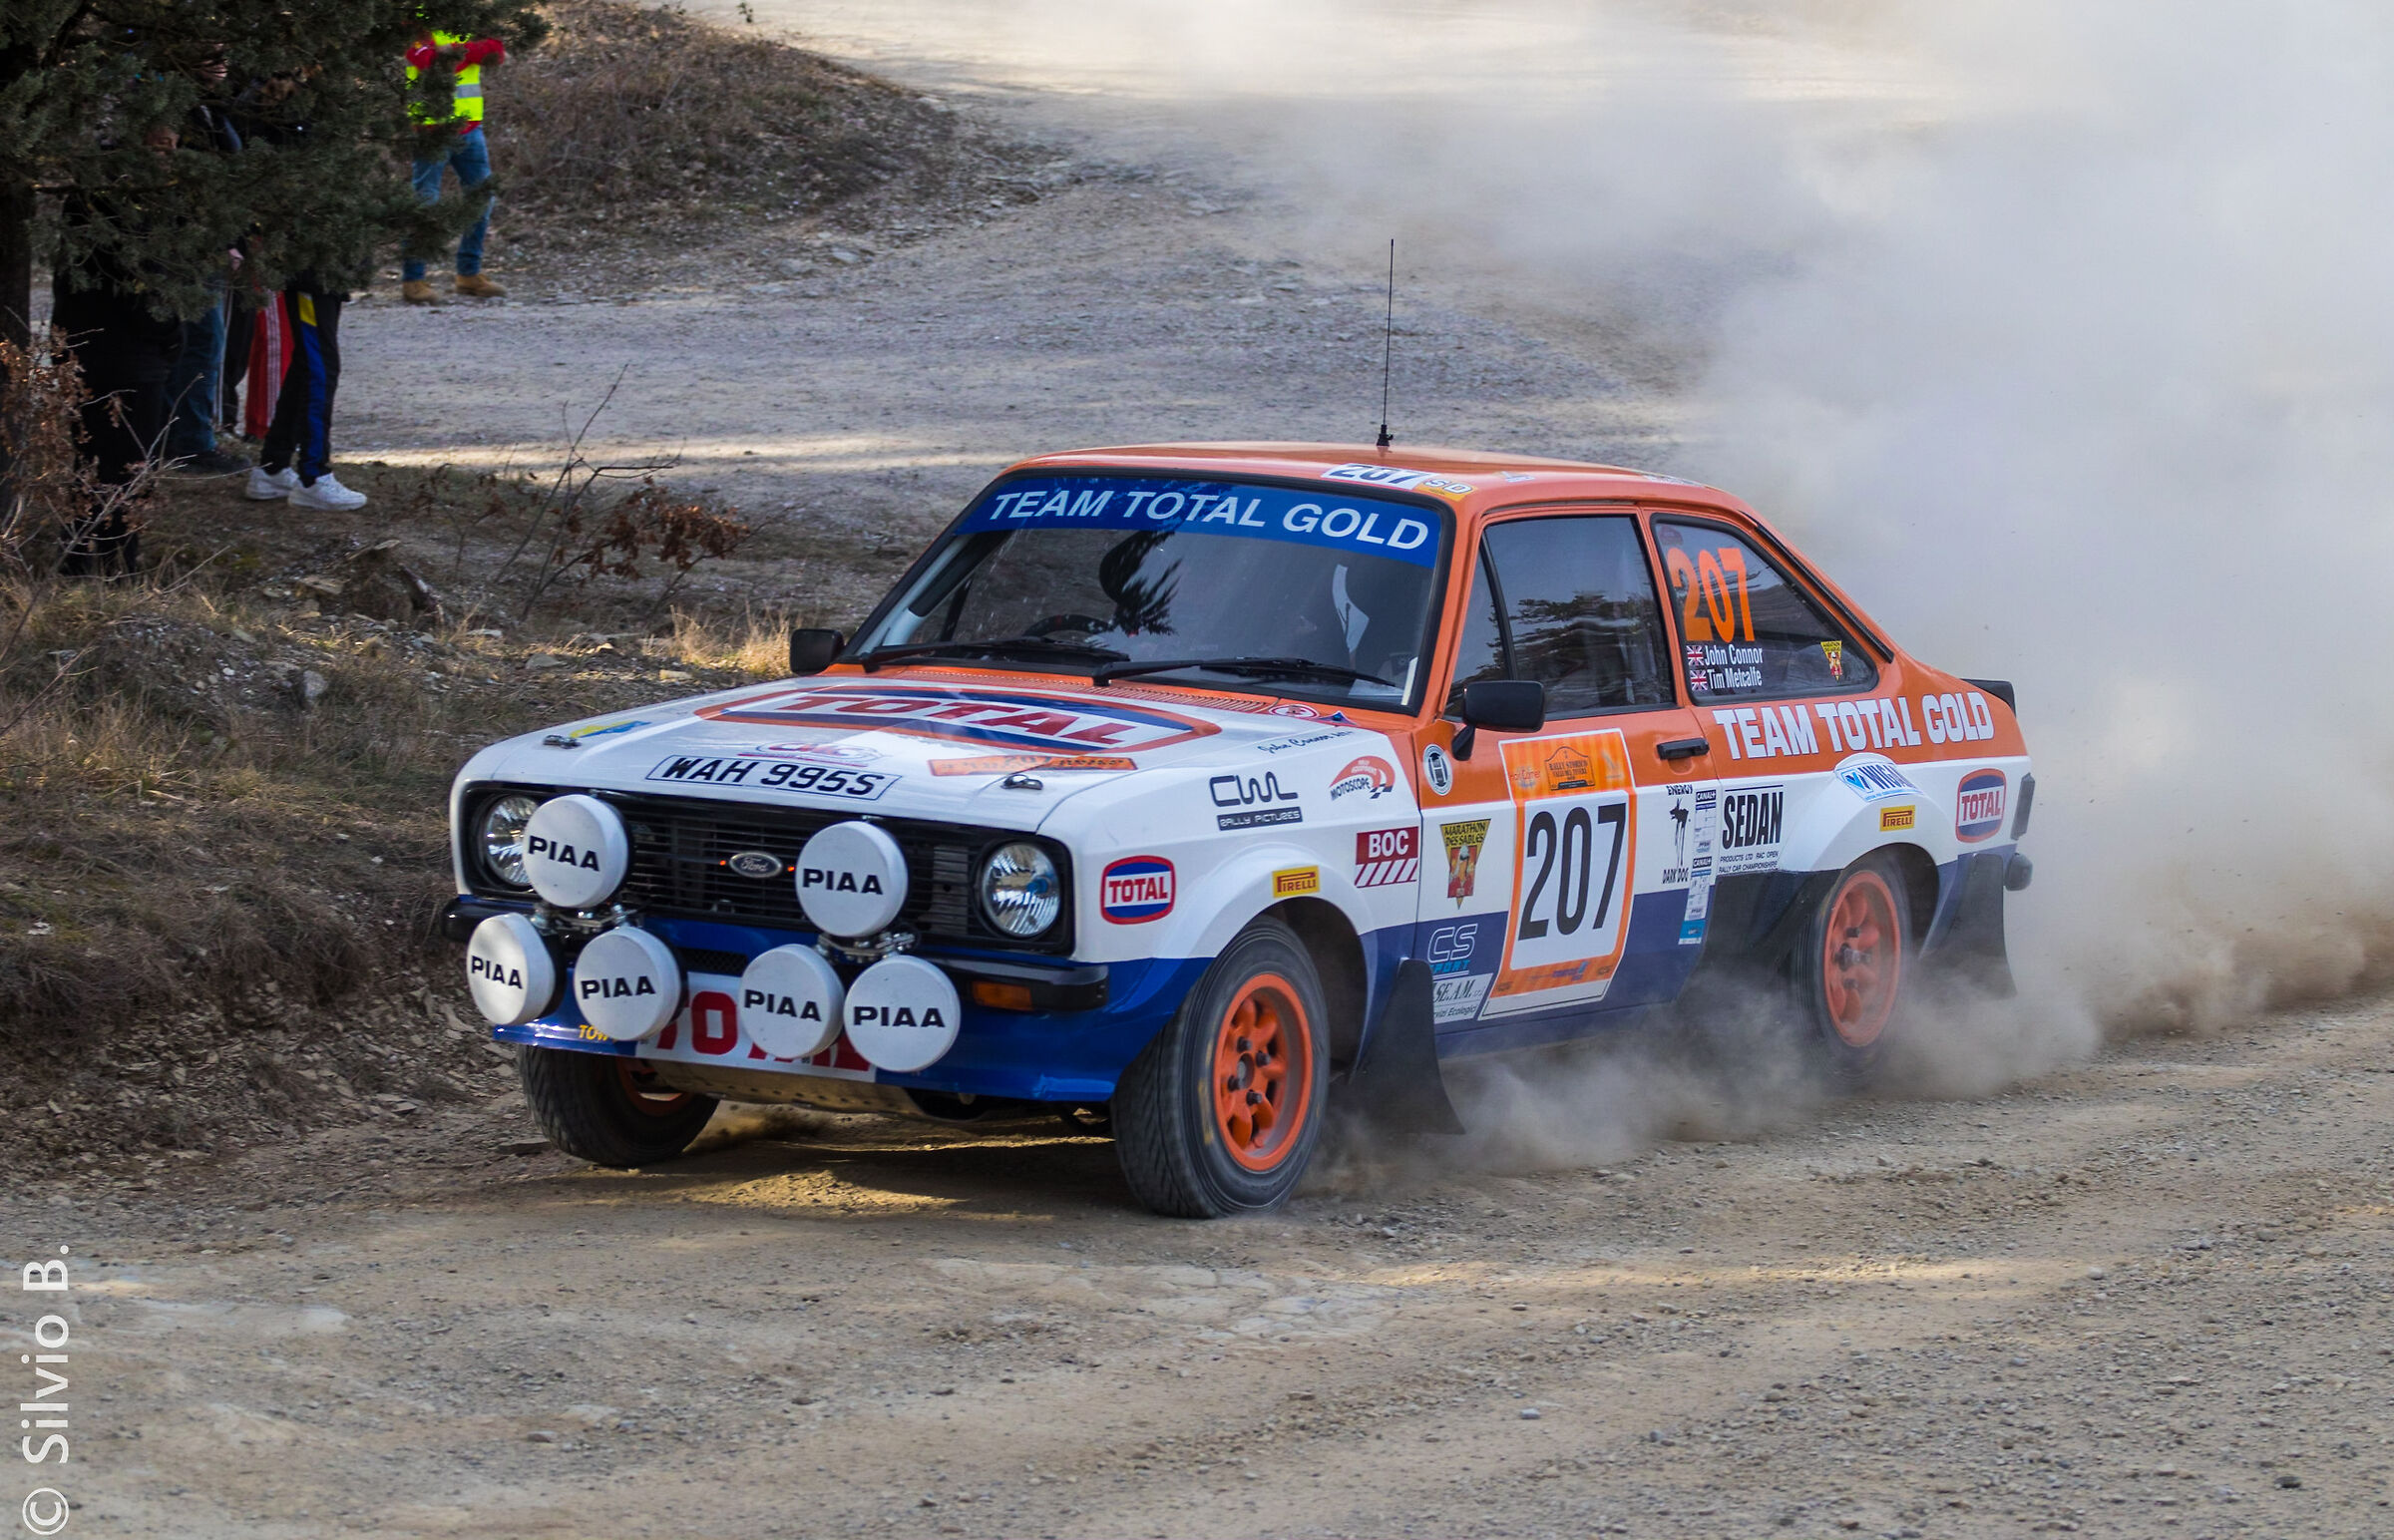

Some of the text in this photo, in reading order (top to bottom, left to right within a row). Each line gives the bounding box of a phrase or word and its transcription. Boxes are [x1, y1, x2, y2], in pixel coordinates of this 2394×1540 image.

[1330, 464, 1428, 485] 207
[990, 490, 1430, 551] TEAM TOTAL GOLD
[1667, 548, 1755, 642] 207
[1705, 643, 1764, 666] John Connor
[1707, 666, 1763, 689] Tim Metcalfe
[777, 695, 1136, 745] TOTAL
[1712, 691, 1995, 760] TEAM TOTAL GOLD
[660, 757, 885, 796] WAH 995S
[1330, 777, 1371, 801] MOTOSCOPE
[1666, 784, 1693, 796] ENERGY
[1219, 811, 1300, 827] RALLY PICTURES
[1883, 810, 1913, 828] PIRELLI
[1961, 790, 2001, 821] TOTAL
[1444, 822, 1486, 835] MARATHON
[1722, 791, 1784, 850] SEDAN
[527, 834, 599, 873] PIAA
[1368, 830, 1409, 859] BOC
[1720, 854, 1744, 863] PRODUCTS
[741, 857, 768, 872] Ford
[1518, 802, 1627, 941] 207
[1662, 869, 1677, 885] DARK
[1677, 868, 1689, 883] DOG
[802, 868, 884, 896] PIAA
[1108, 876, 1168, 904] TOTAL
[1277, 870, 1317, 893] PIRELLI
[1427, 923, 1478, 963] CS
[470, 954, 524, 990] PIAA
[581, 974, 655, 999] PIAA
[744, 989, 821, 1022] PIAA
[853, 1004, 946, 1029] PIAA
